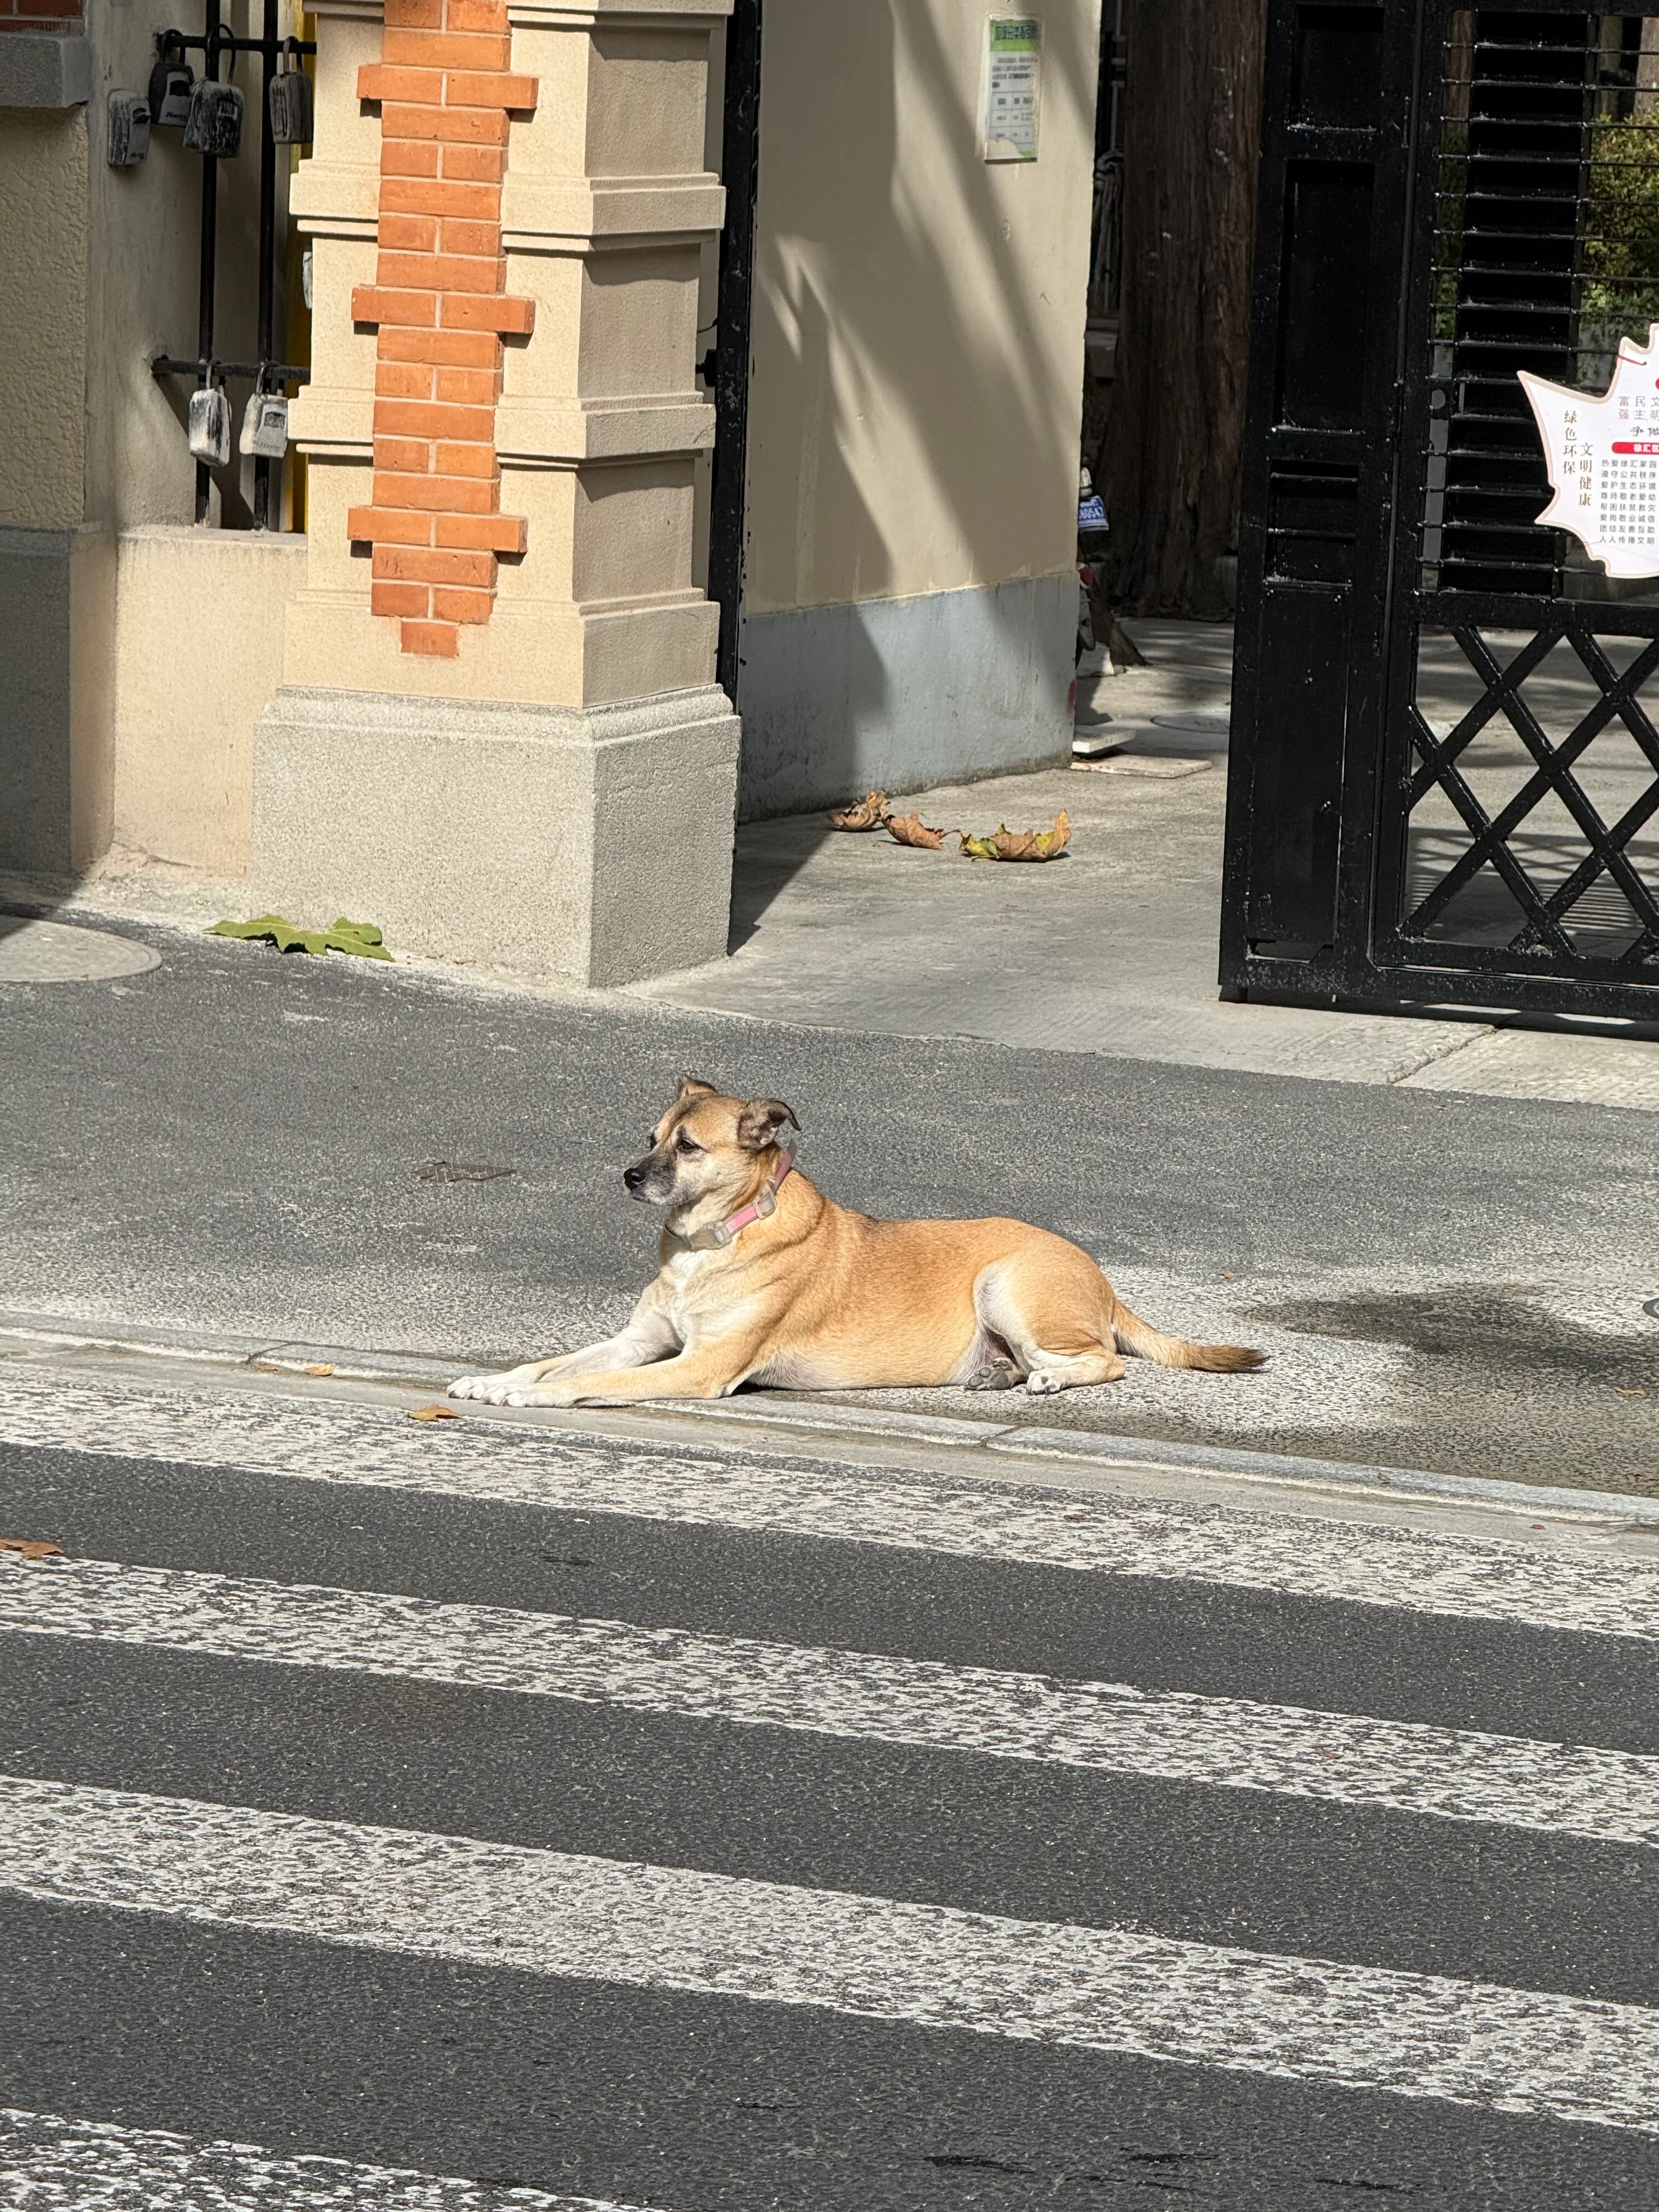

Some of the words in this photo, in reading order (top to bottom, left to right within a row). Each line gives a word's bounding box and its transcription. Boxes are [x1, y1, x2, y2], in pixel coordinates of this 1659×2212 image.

[1563, 410, 1577, 475] 绿色环保
[1578, 442, 1593, 506] 文明健康
[1601, 470, 1656, 479] 遵守公共秩序
[1601, 481, 1656, 490] 爱护生态环境
[1079, 506, 1104, 520] 80547
[1600, 514, 1655, 523] 爱岗敬业诚信
[1599, 524, 1655, 534] 团结友善互助
[1599, 535, 1655, 545] 人人传播文明
